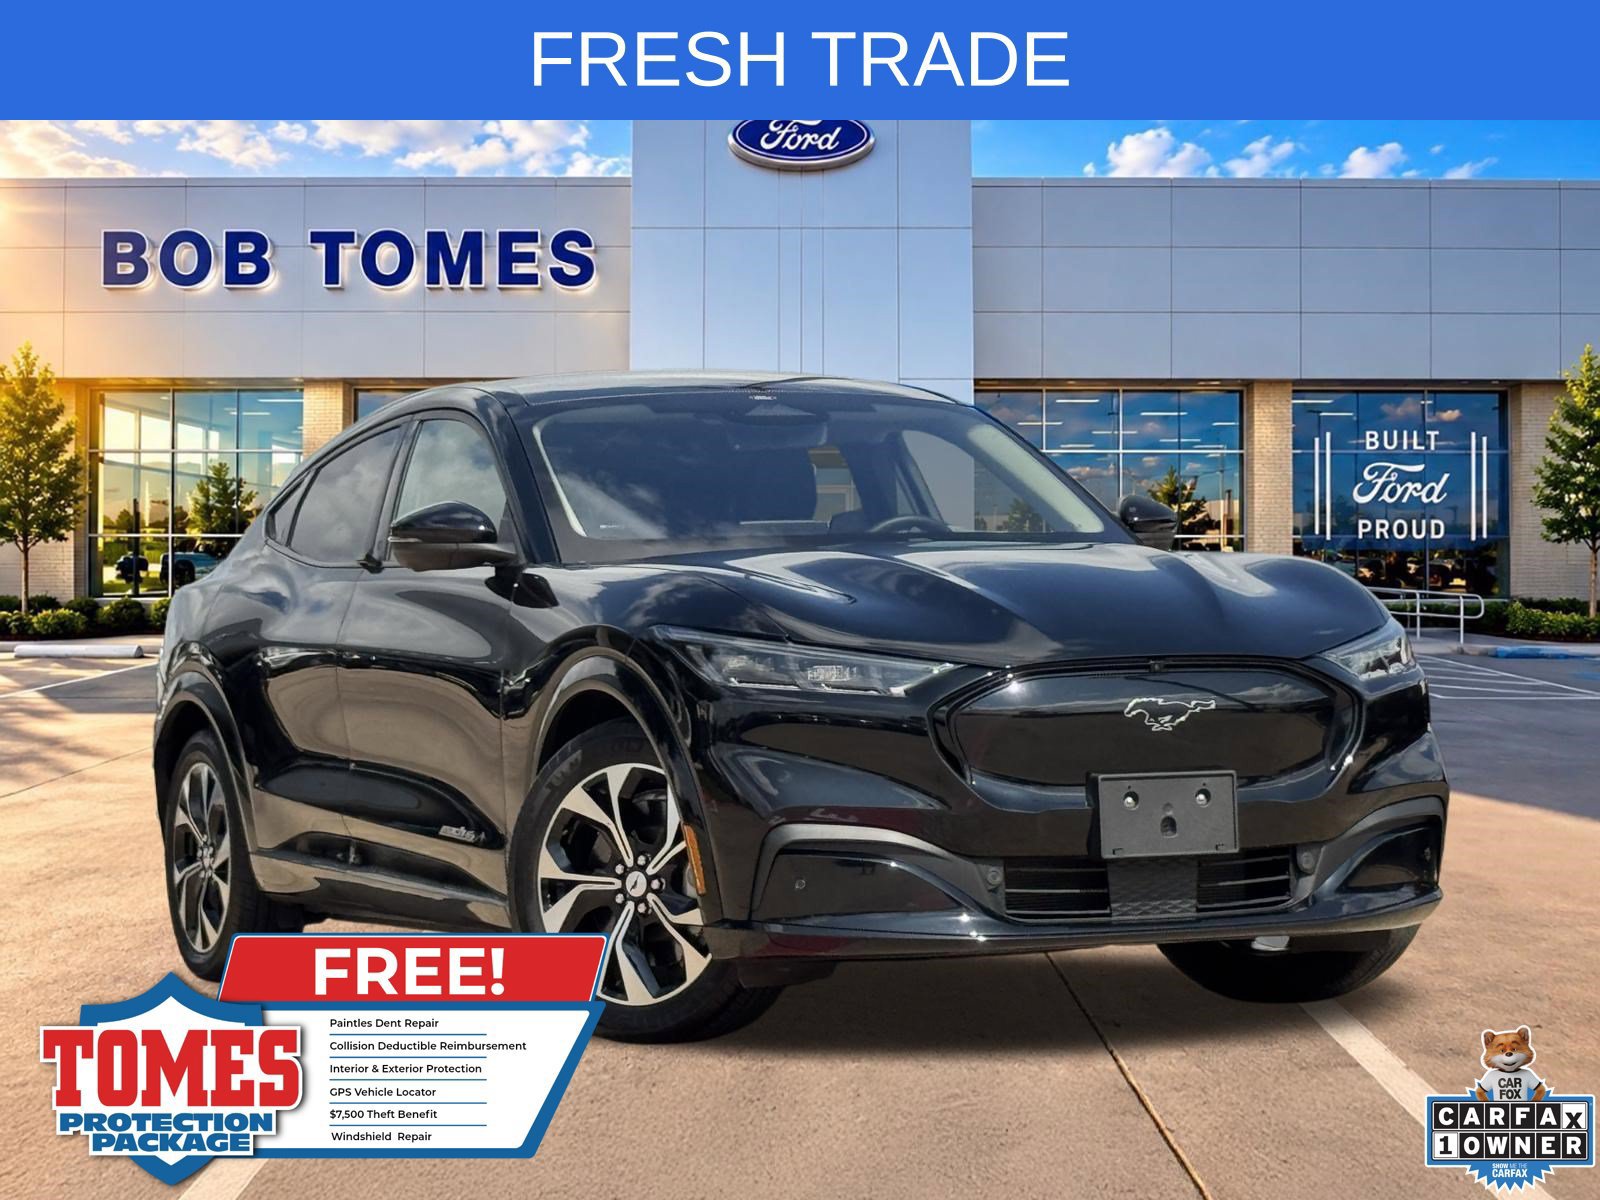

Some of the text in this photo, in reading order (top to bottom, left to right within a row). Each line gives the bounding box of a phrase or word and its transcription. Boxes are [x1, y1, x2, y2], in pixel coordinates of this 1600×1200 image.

[760, 120, 841, 150] Ford
[102, 229, 595, 288] BOB TOMES
[1365, 430, 1439, 450] BUILT
[1353, 462, 1450, 504] Ford
[1358, 519, 1445, 539] PROUD
